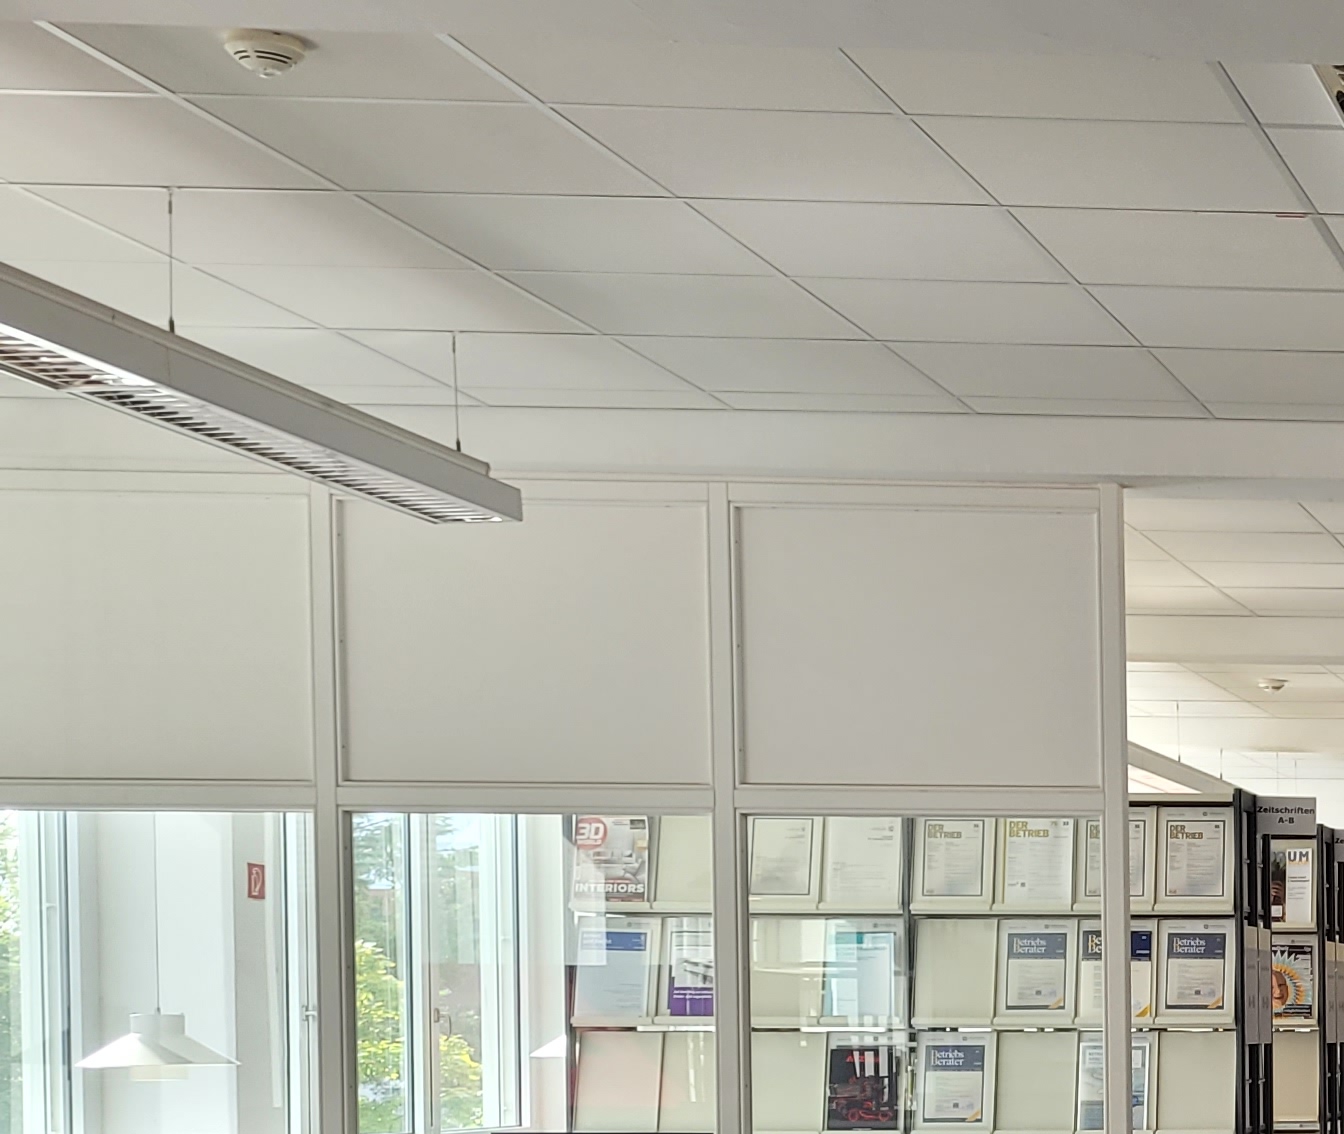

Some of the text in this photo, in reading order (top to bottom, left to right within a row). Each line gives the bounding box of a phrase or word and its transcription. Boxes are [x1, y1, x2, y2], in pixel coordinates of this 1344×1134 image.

[1257, 806, 1315, 814] Zeitschriften
[927, 824, 944, 832] DER
[1009, 821, 1029, 829] DER
[576, 823, 605, 839] 3D
[1009, 829, 1049, 838] BETRIEB
[575, 883, 644, 893] INTERIORS
